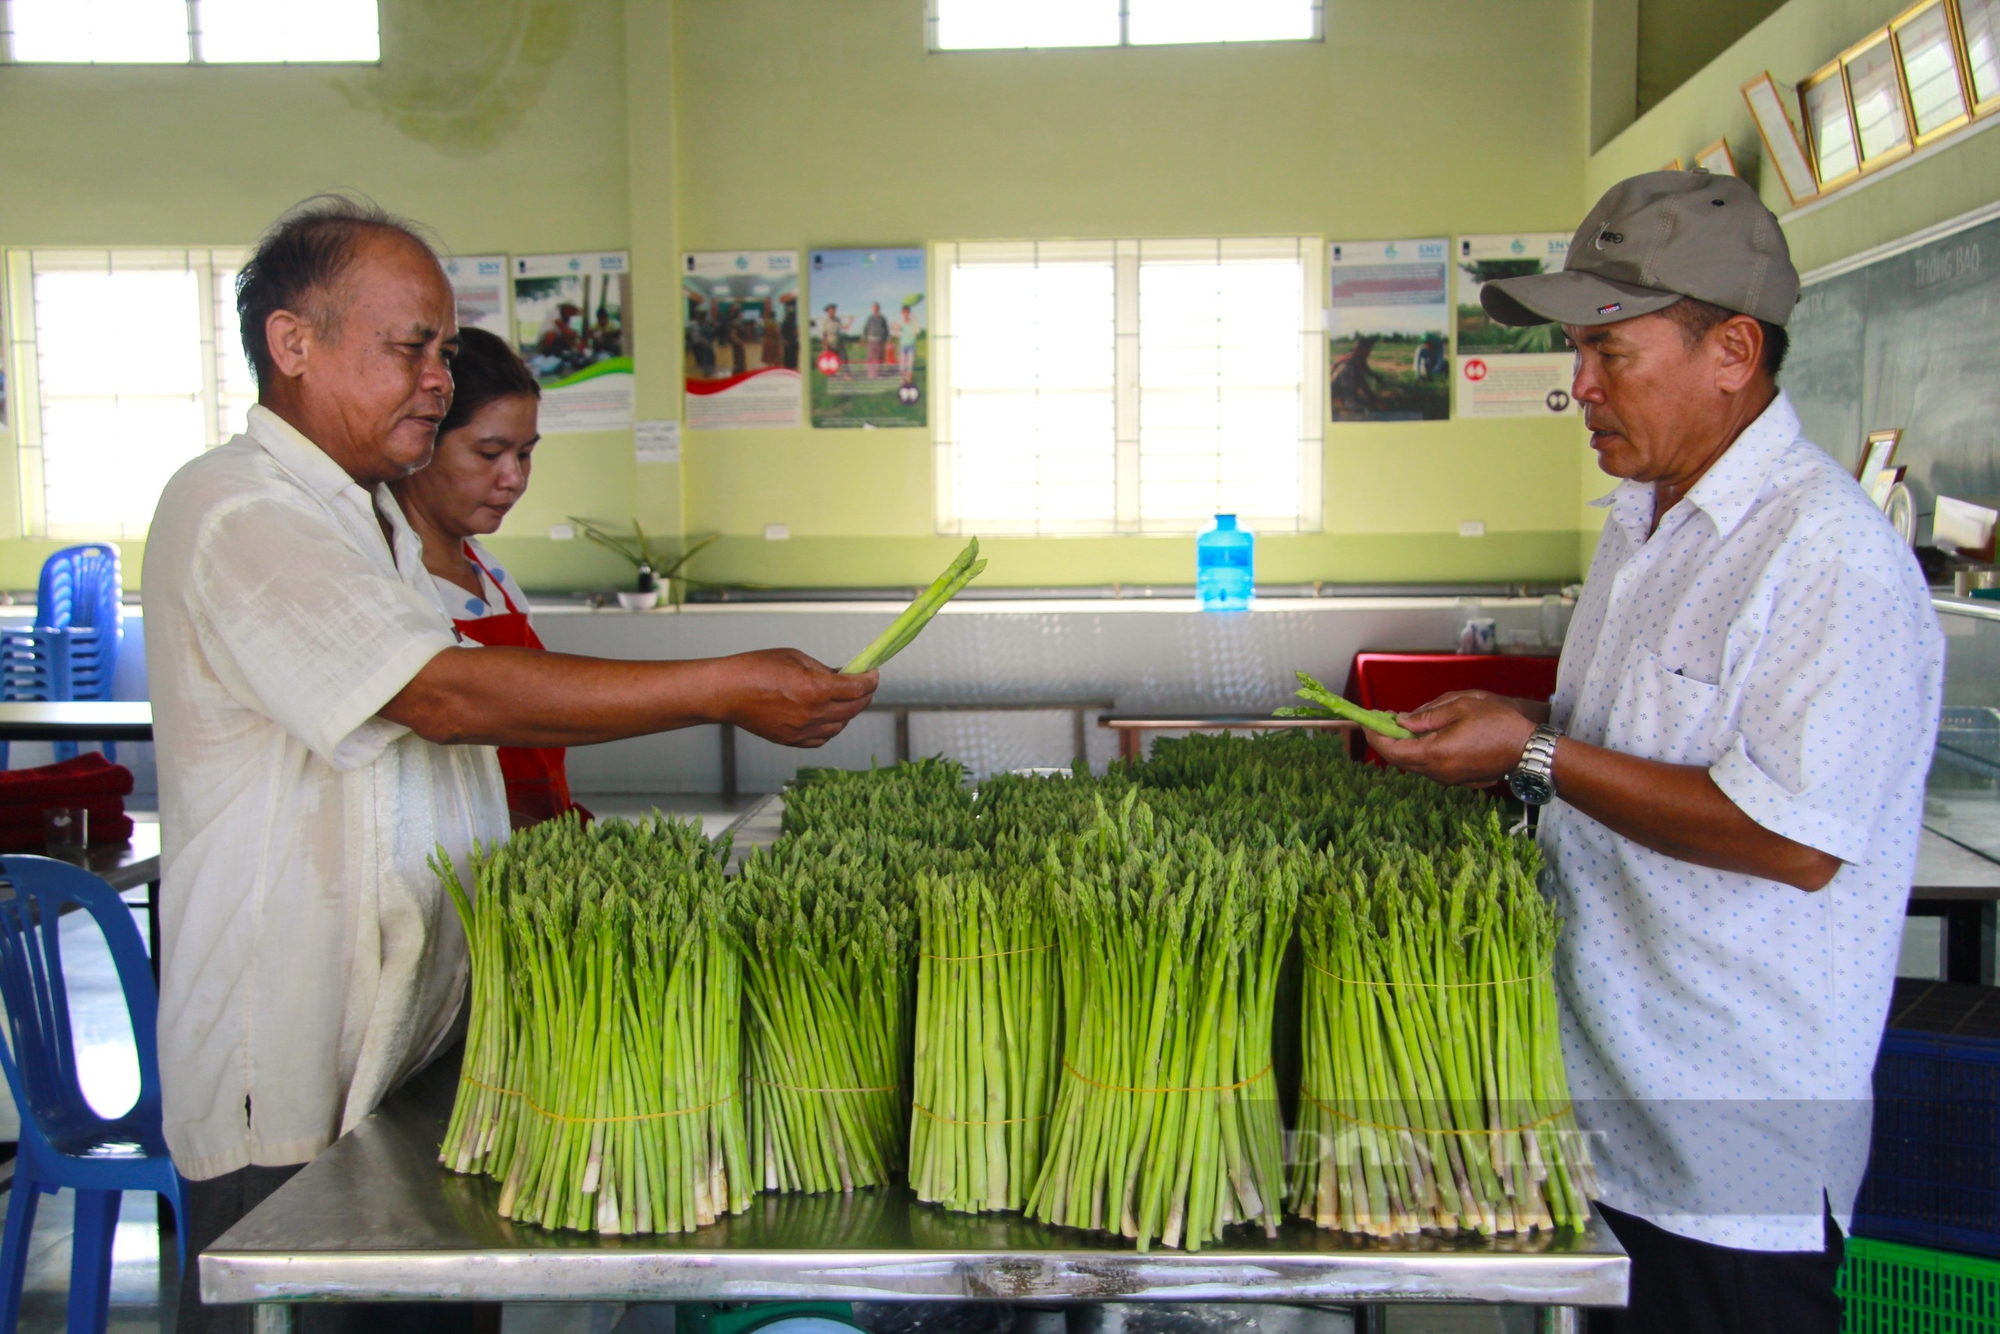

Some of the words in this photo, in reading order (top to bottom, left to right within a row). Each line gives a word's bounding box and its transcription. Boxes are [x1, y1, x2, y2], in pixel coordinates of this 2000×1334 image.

[1418, 244, 1443, 254] SNV
[768, 256, 792, 266] SNV
[896, 255, 921, 266] SNV
